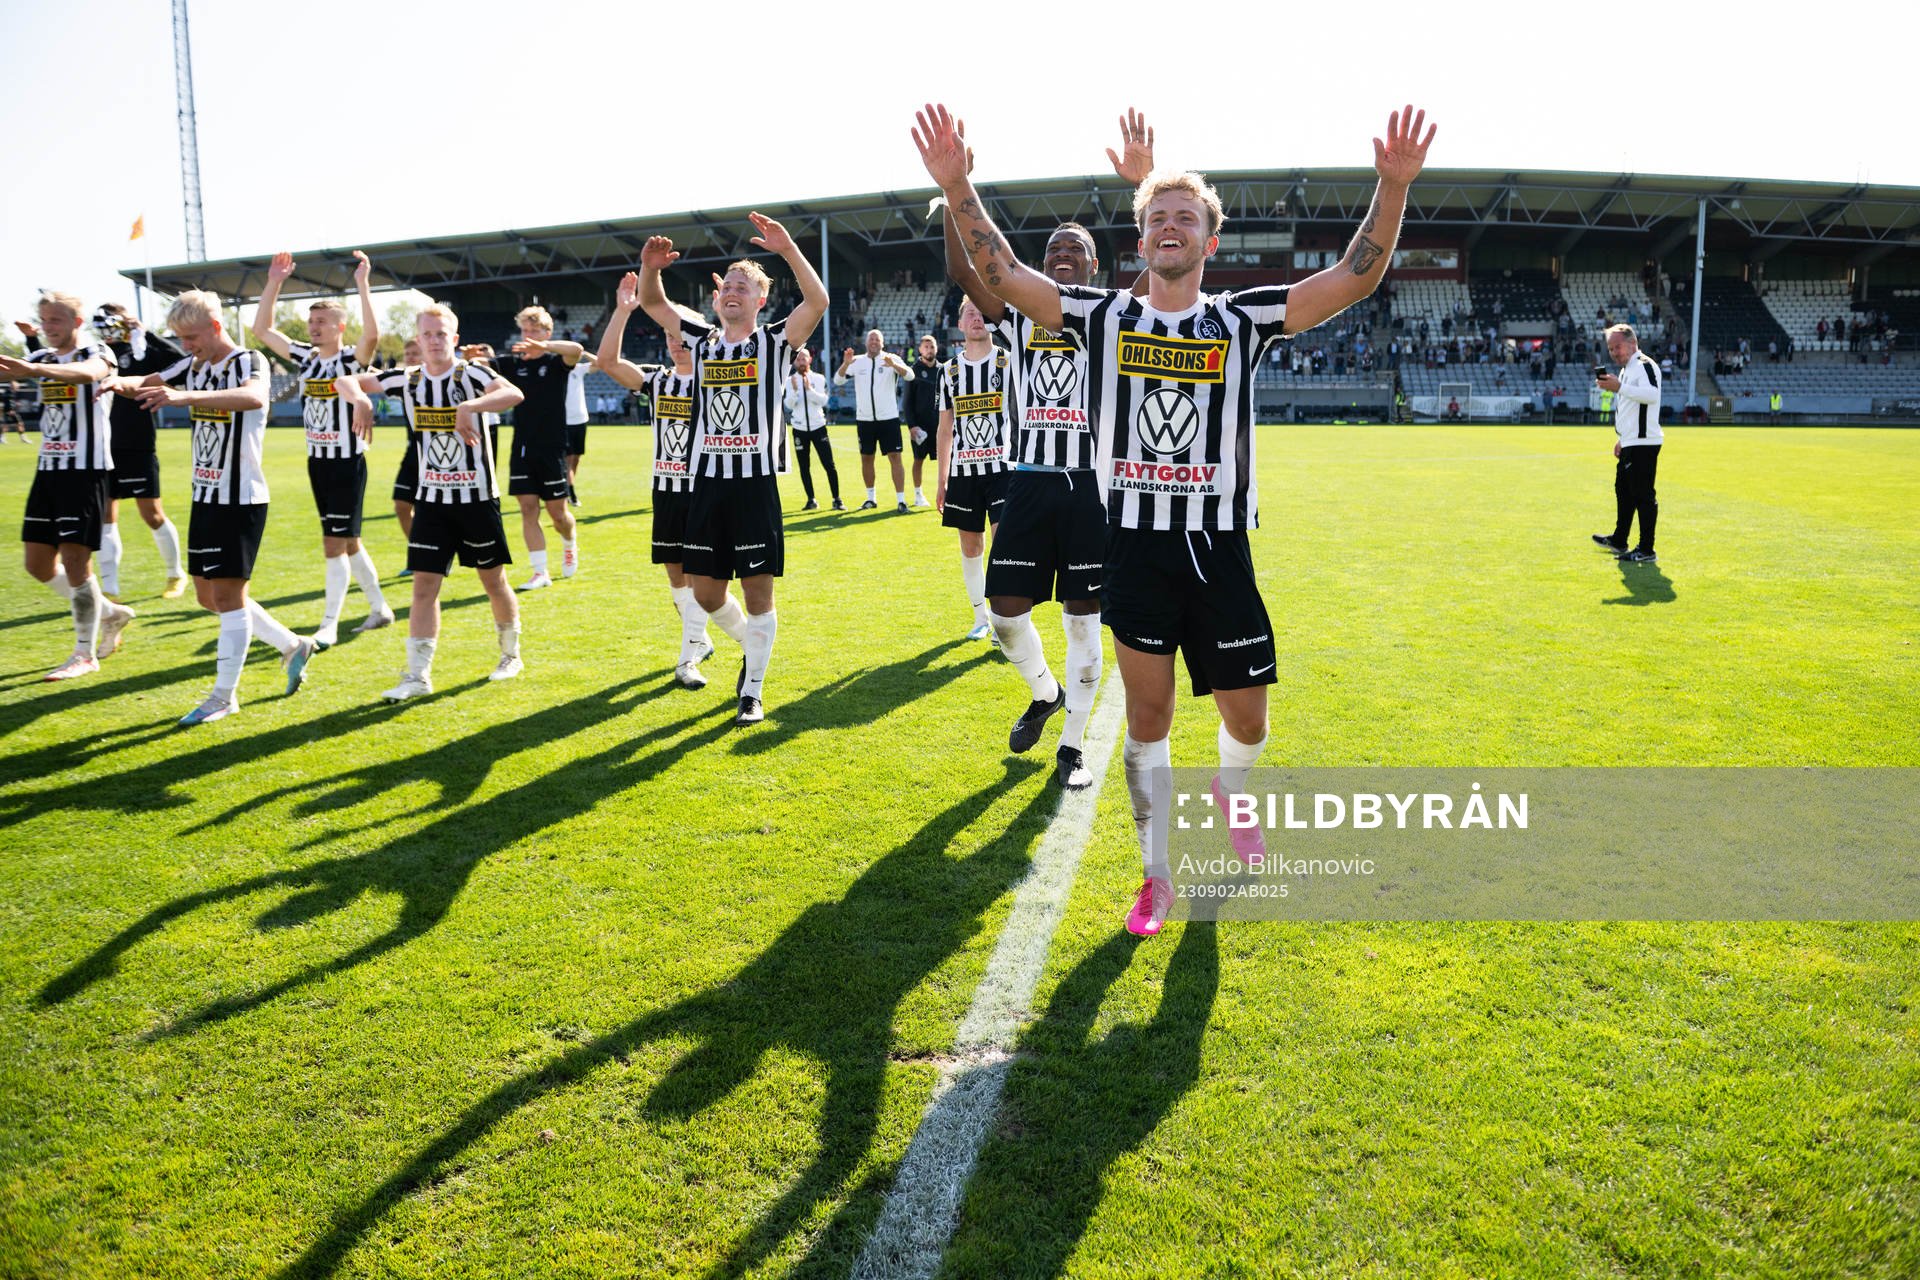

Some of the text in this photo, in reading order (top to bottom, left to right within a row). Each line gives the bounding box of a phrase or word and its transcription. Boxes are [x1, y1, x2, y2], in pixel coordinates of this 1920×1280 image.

[1122, 344, 1206, 370] OHLSSONS
[1038, 357, 1076, 396] VW
[659, 402, 691, 414] OHLSSON
[711, 393, 743, 427] VW
[956, 398, 993, 410] OHLSSONS
[1026, 408, 1087, 423] FLYTGOLV
[1140, 390, 1198, 449] VW
[966, 418, 993, 445] VW
[1028, 422, 1074, 430] LANDSKRONA
[704, 435, 758, 446] FLYTGOLV
[431, 436, 460, 465] VW
[958, 447, 1003, 459] FLYTGOLV
[656, 461, 688, 471] FLYTGO
[1113, 460, 1217, 482] FLYTGOLV
[1120, 479, 1196, 493] LANDSKRONA
[1199, 484, 1215, 493] AB
